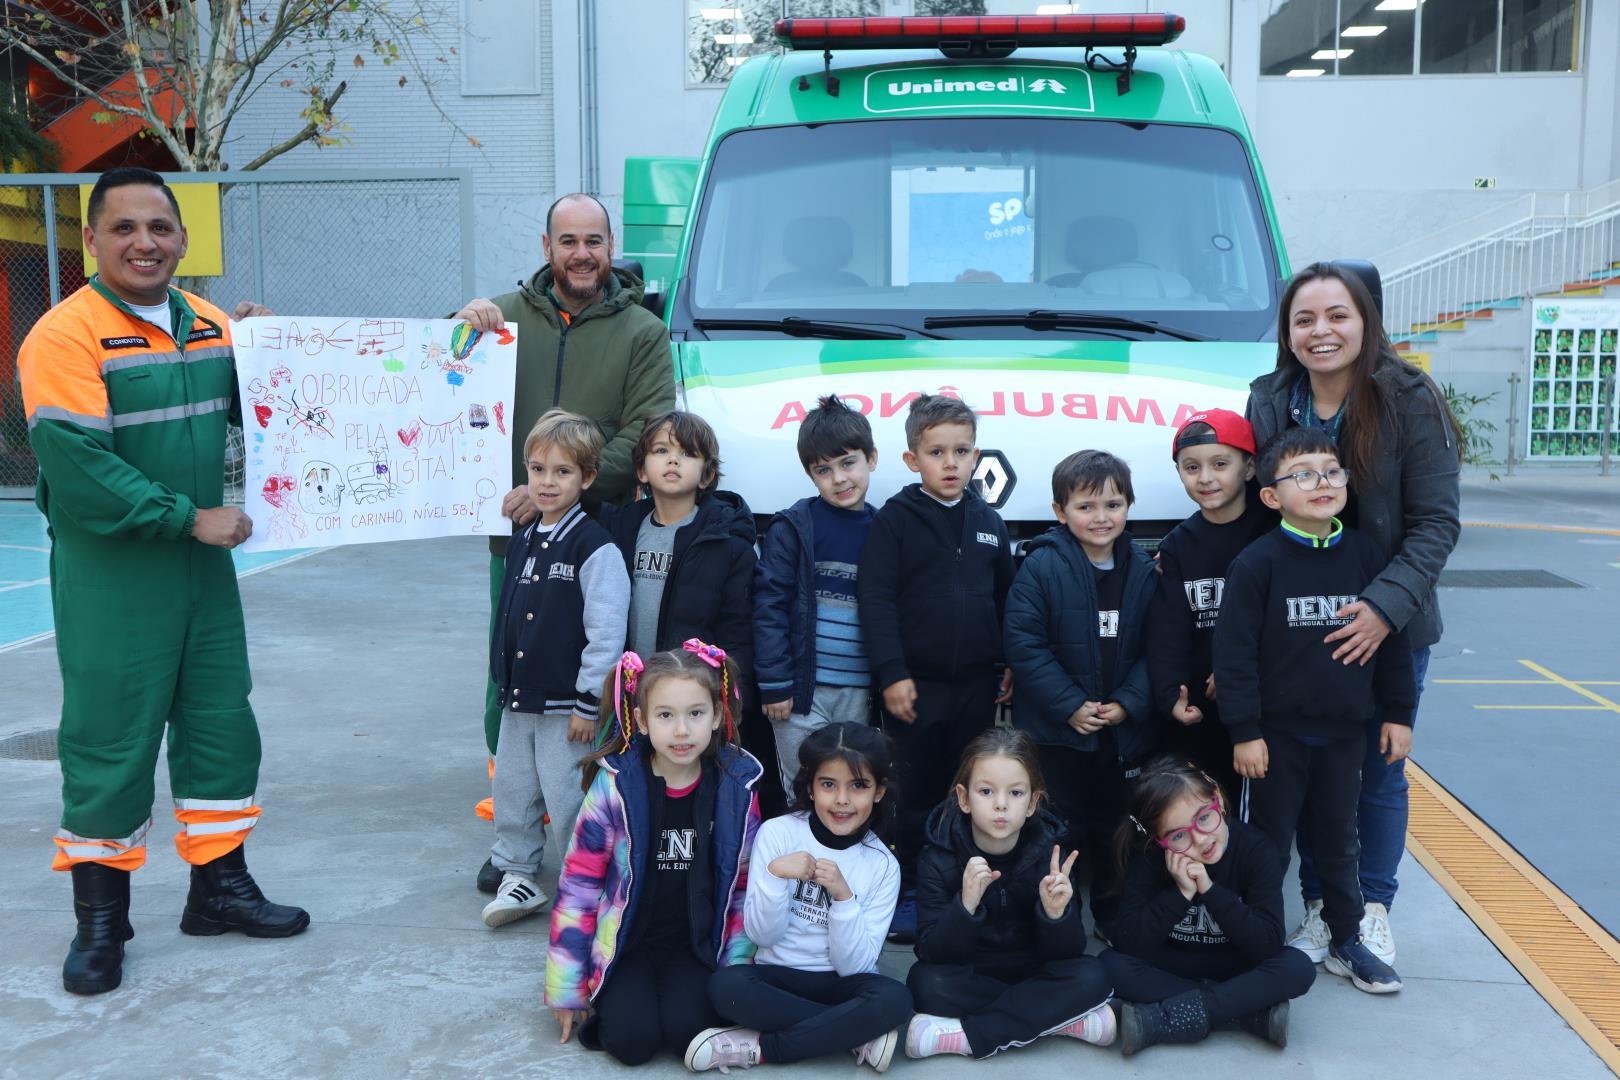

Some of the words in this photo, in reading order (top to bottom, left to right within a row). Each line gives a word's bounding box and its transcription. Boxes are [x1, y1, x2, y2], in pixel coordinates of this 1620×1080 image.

[888, 77, 1018, 96] Unimed
[302, 375, 423, 406] OBRIGADA
[345, 423, 389, 452] PELA
[316, 516, 341, 532] COM
[351, 509, 407, 528] CARINHO,
[413, 502, 447, 520] NÍVEL
